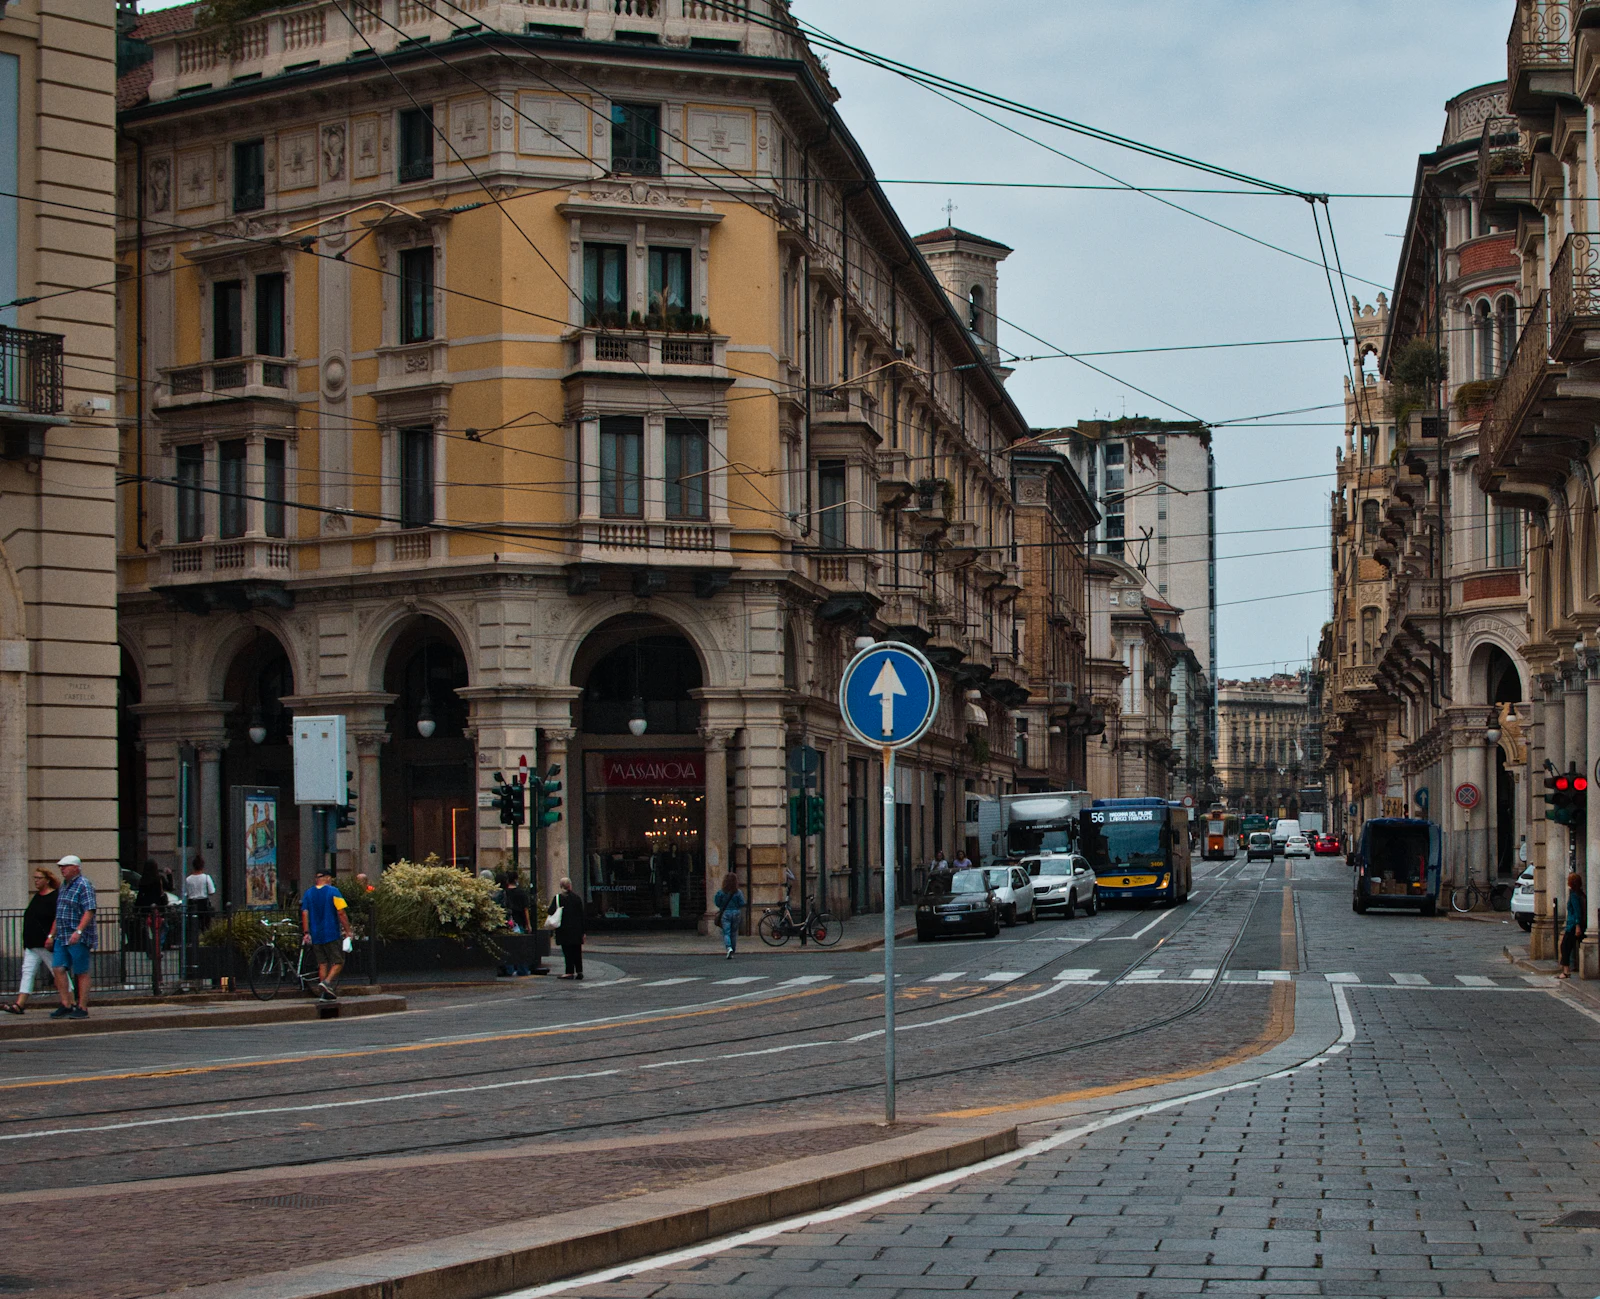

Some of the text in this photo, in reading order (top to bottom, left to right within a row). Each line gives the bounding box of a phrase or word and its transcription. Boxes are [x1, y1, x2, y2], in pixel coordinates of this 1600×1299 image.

[64, 693, 95, 701] CASTELLO
[608, 762, 696, 780] MASSANOVA
[1091, 812, 1104, 823] 56
